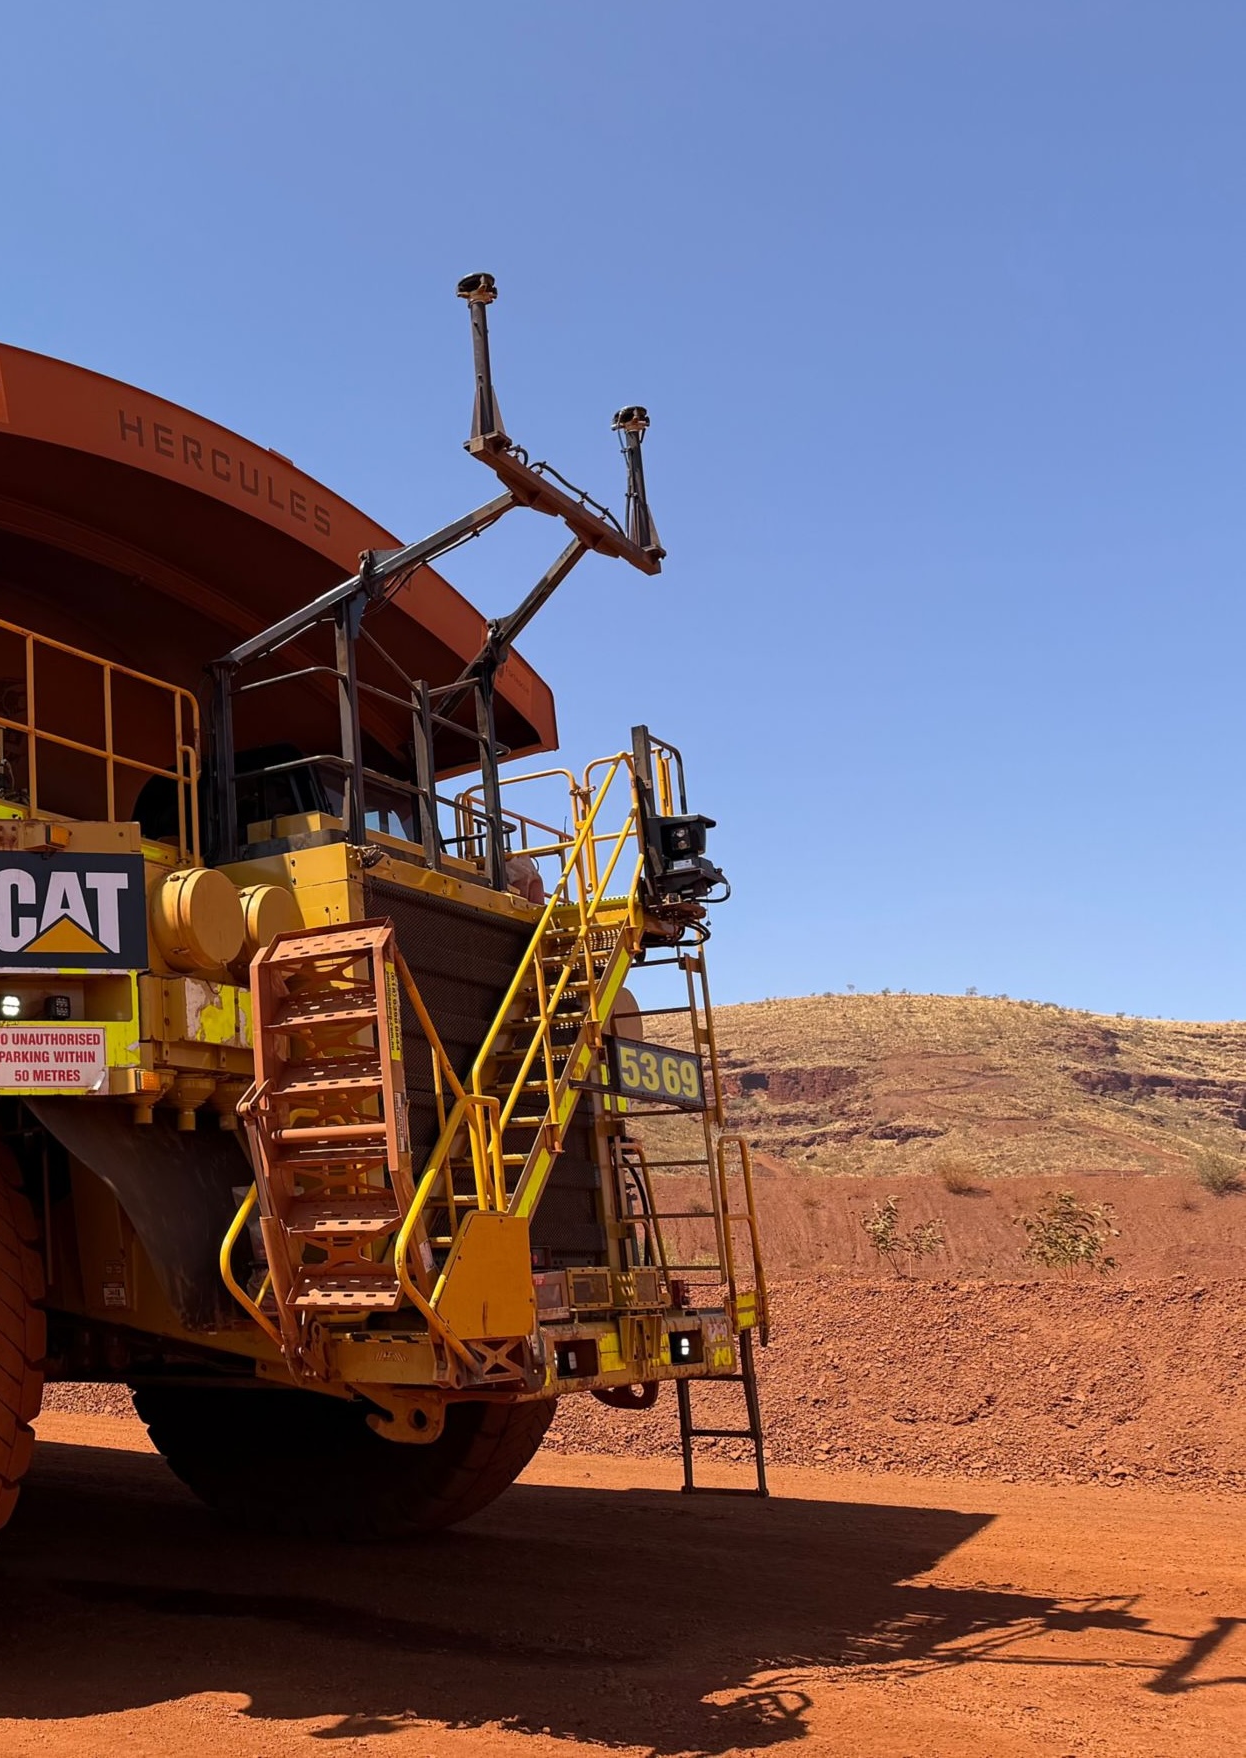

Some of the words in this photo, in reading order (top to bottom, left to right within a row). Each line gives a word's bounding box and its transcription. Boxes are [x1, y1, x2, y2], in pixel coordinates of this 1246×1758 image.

[117, 408, 332, 537] HERCULES
[11, 1032, 101, 1047] UNAUTHORISED
[53, 1050, 96, 1064] WITHIN
[14, 1069, 30, 1083] 50
[32, 1069, 81, 1083] METRES
[619, 1046, 699, 1098] 5369
